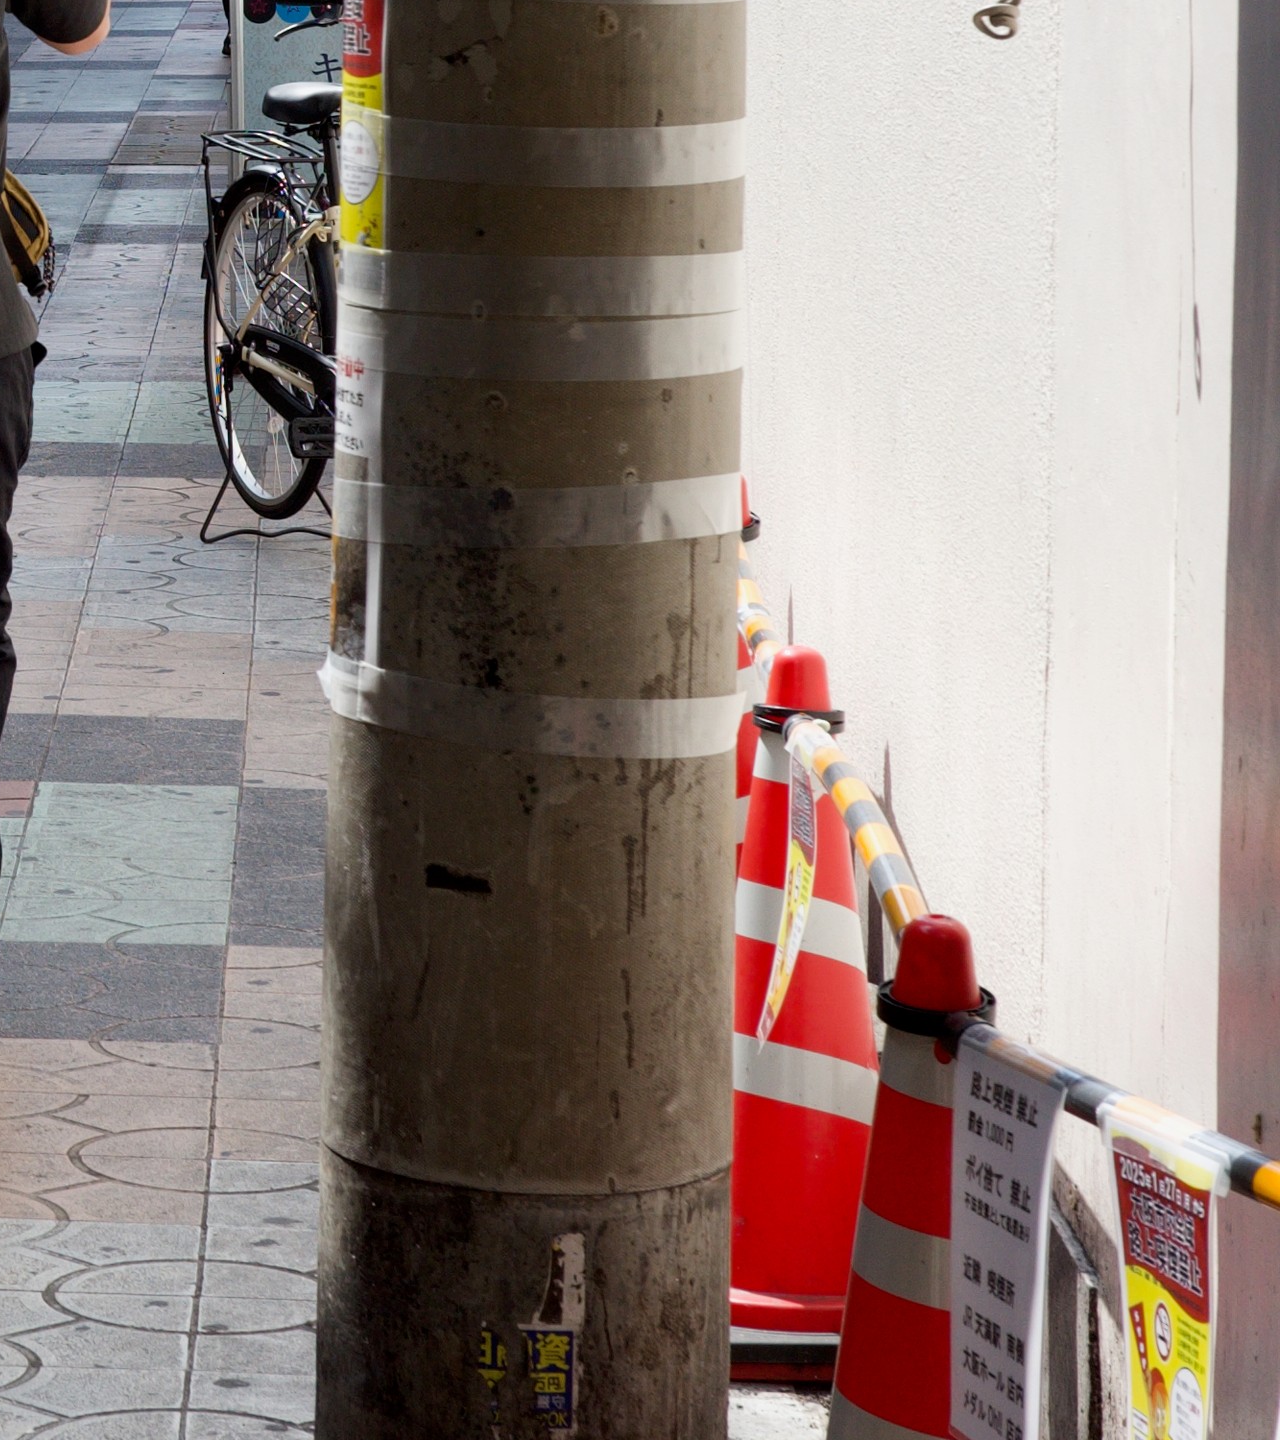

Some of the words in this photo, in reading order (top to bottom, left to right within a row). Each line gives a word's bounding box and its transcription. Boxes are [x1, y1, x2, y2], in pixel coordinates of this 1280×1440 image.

[1009, 1177, 1032, 1215] 禁止
[1127, 1218, 1204, 1298] 路上喫煙禁止
